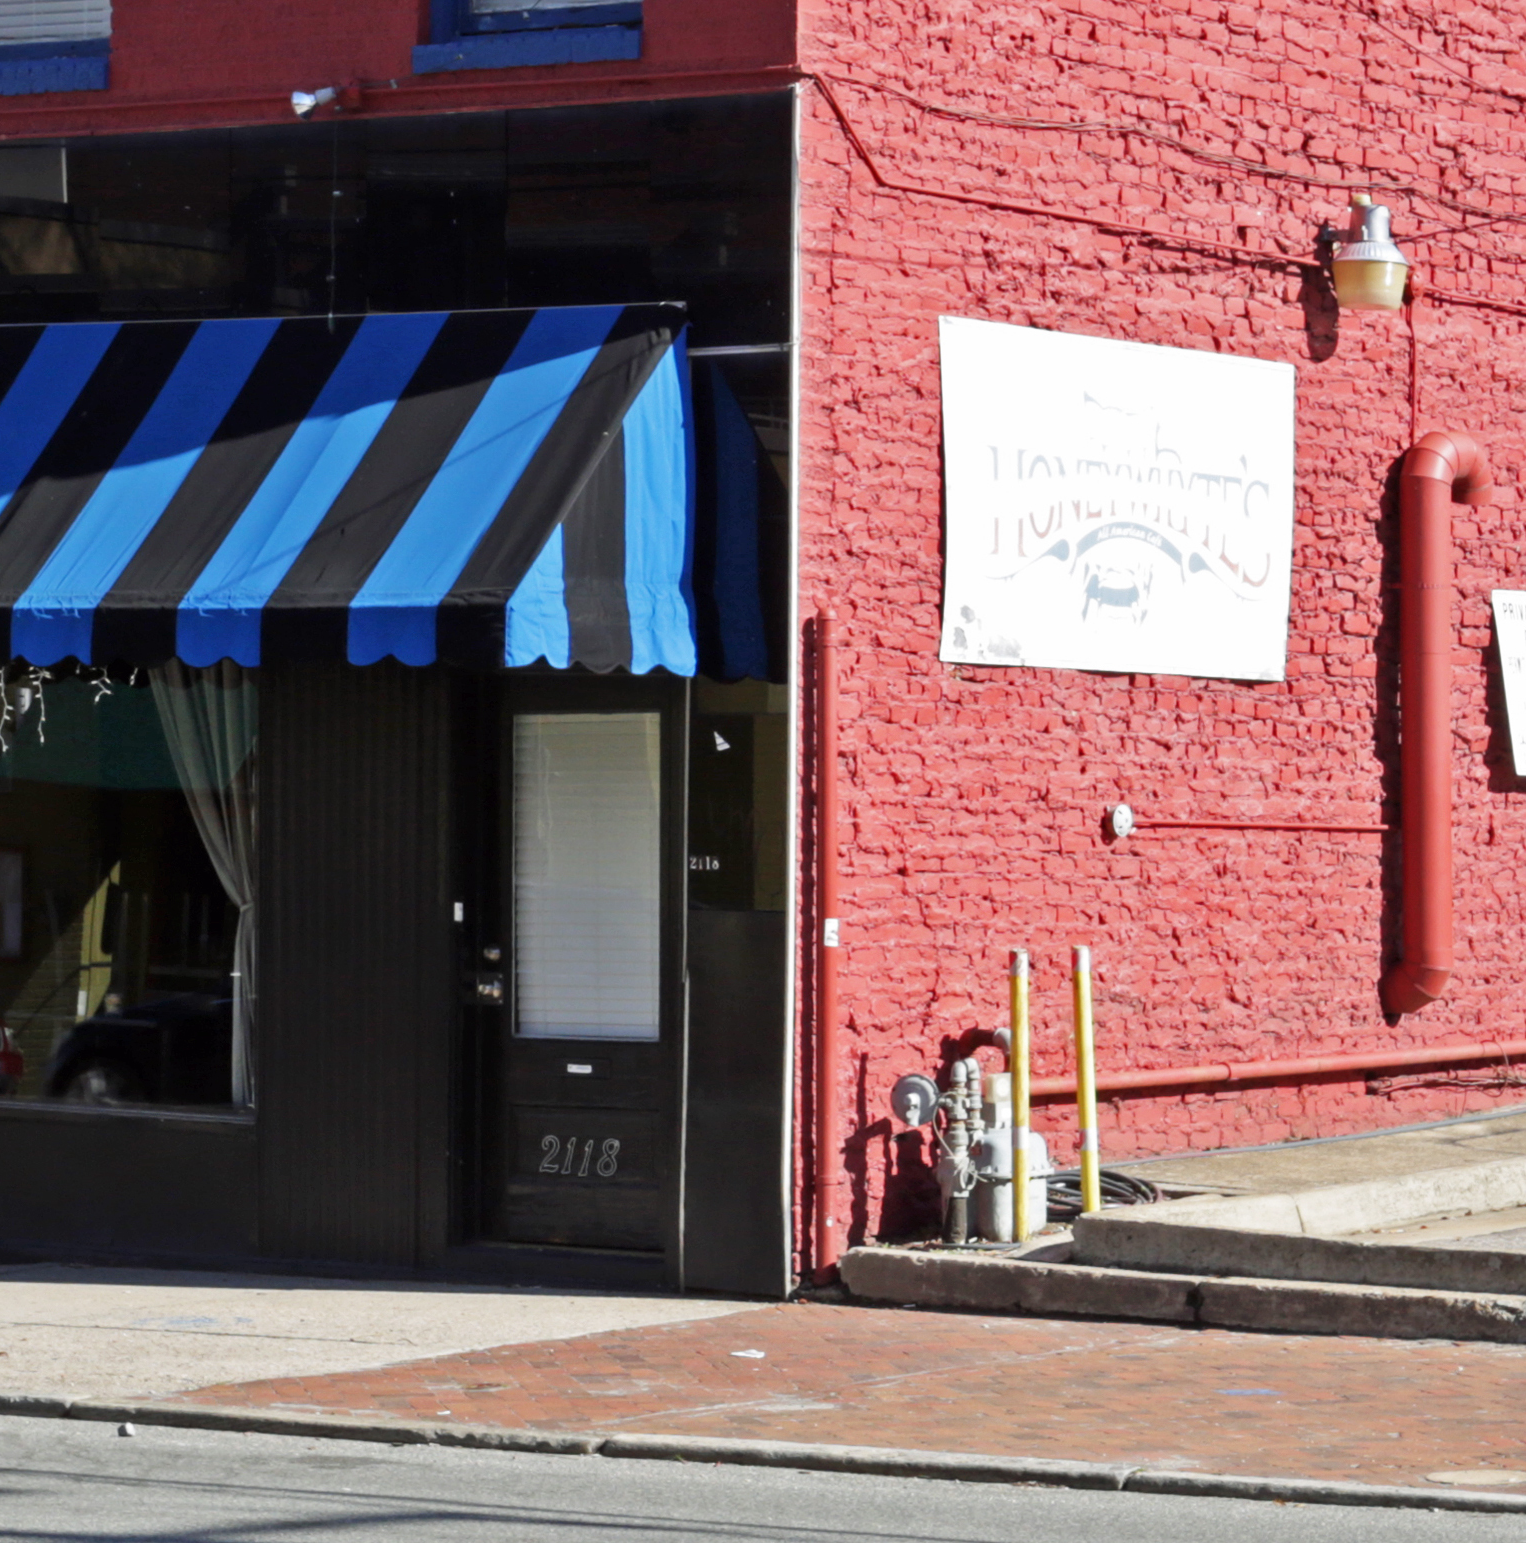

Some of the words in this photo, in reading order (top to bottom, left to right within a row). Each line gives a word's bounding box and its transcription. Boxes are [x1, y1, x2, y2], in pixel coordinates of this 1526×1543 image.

[1110, 524, 1146, 539] American
[689, 855, 720, 871] 2118
[539, 1134, 621, 1177] 2118
